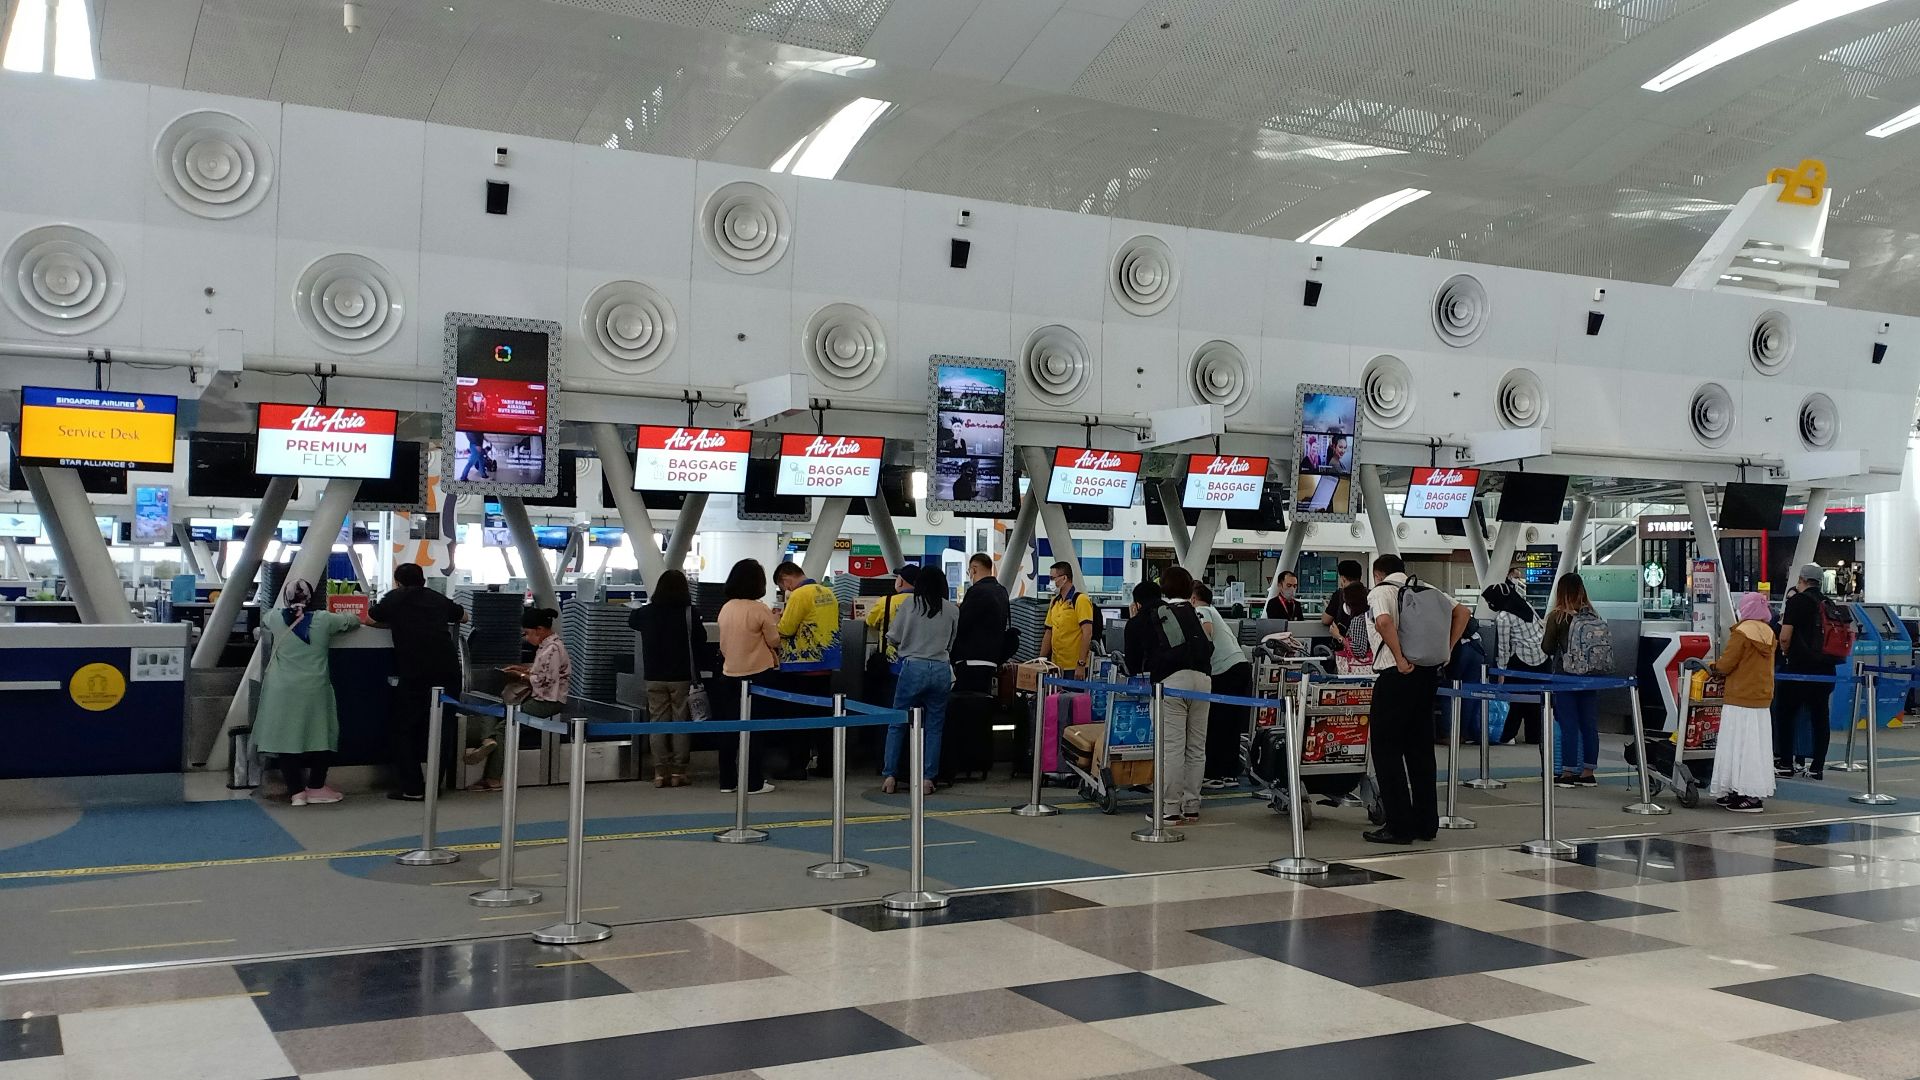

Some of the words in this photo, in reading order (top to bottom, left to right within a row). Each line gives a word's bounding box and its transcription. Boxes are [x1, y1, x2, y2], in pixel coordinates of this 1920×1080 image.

[56, 396, 99, 406] SINGAPORE
[102, 399, 135, 408] AIRLINES
[58, 425, 105, 438] Service
[111, 427, 140, 440] Desk
[286, 439, 367, 453] PREMIUM
[60, 458, 81, 466] STAR
[84, 460, 126, 468] ALLIANCE
[303, 453, 347, 466] FLEX
[668, 459, 737, 471] BAGGAGE
[808, 465, 870, 476] BAGGAGE
[667, 471, 708, 482] DROP
[807, 477, 843, 487] DROP
[1075, 476, 1127, 488] BAGGAGE
[1073, 487, 1104, 497] DROP
[1208, 482, 1256, 492] BAGGAGE
[1206, 492, 1234, 501] DROP
[1426, 492, 1467, 501] BAGGAGE
[1424, 501, 1448, 510] DROP
[1647, 521, 1694, 532] STARBUC
